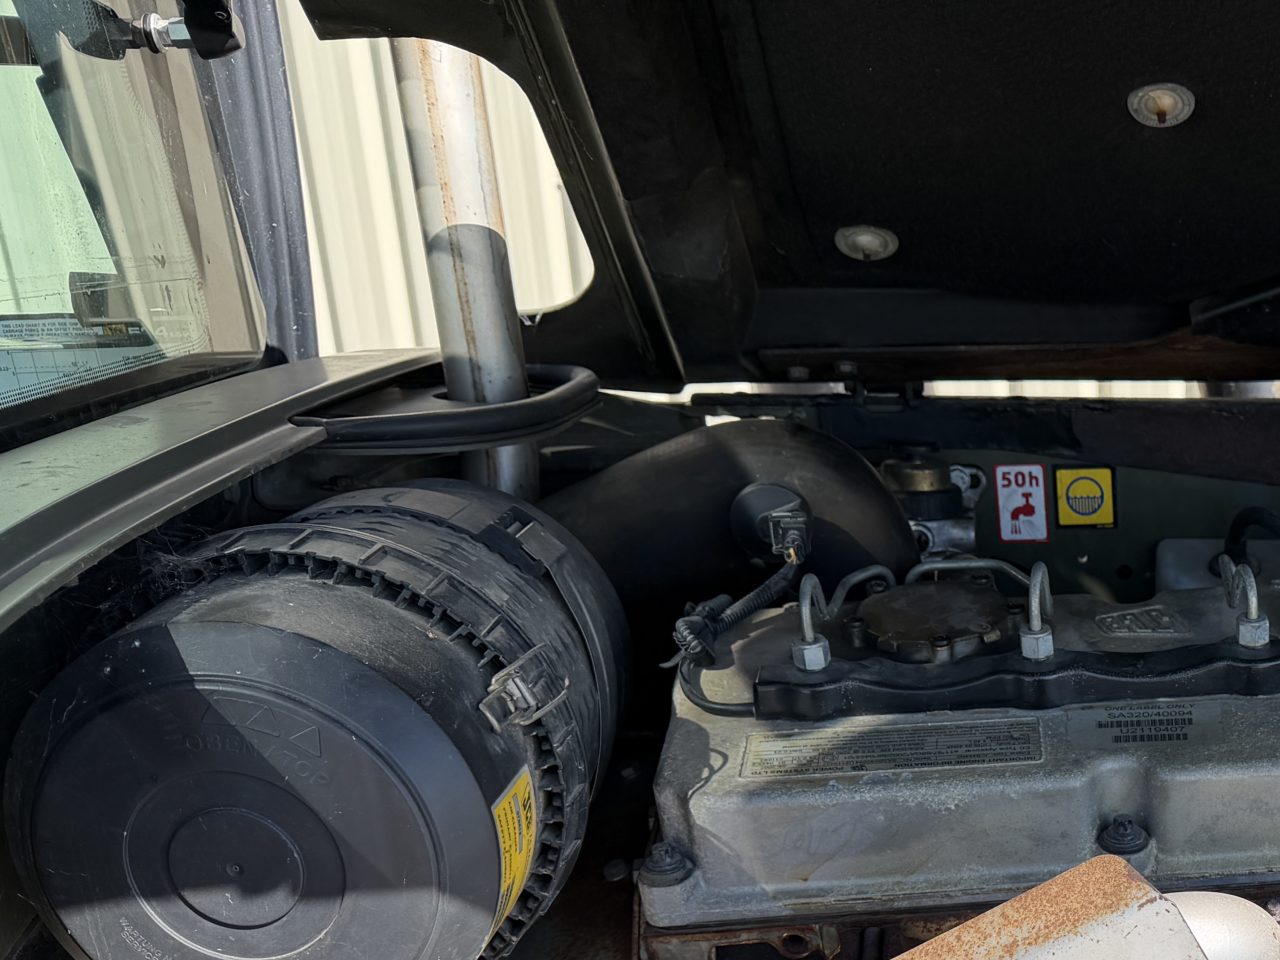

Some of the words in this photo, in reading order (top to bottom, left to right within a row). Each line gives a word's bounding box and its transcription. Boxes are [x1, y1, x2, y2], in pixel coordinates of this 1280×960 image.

[1001, 471, 1039, 488] 50h
[1107, 710, 1193, 719] SA320/40094
[1120, 726, 1185, 734] U2119407
